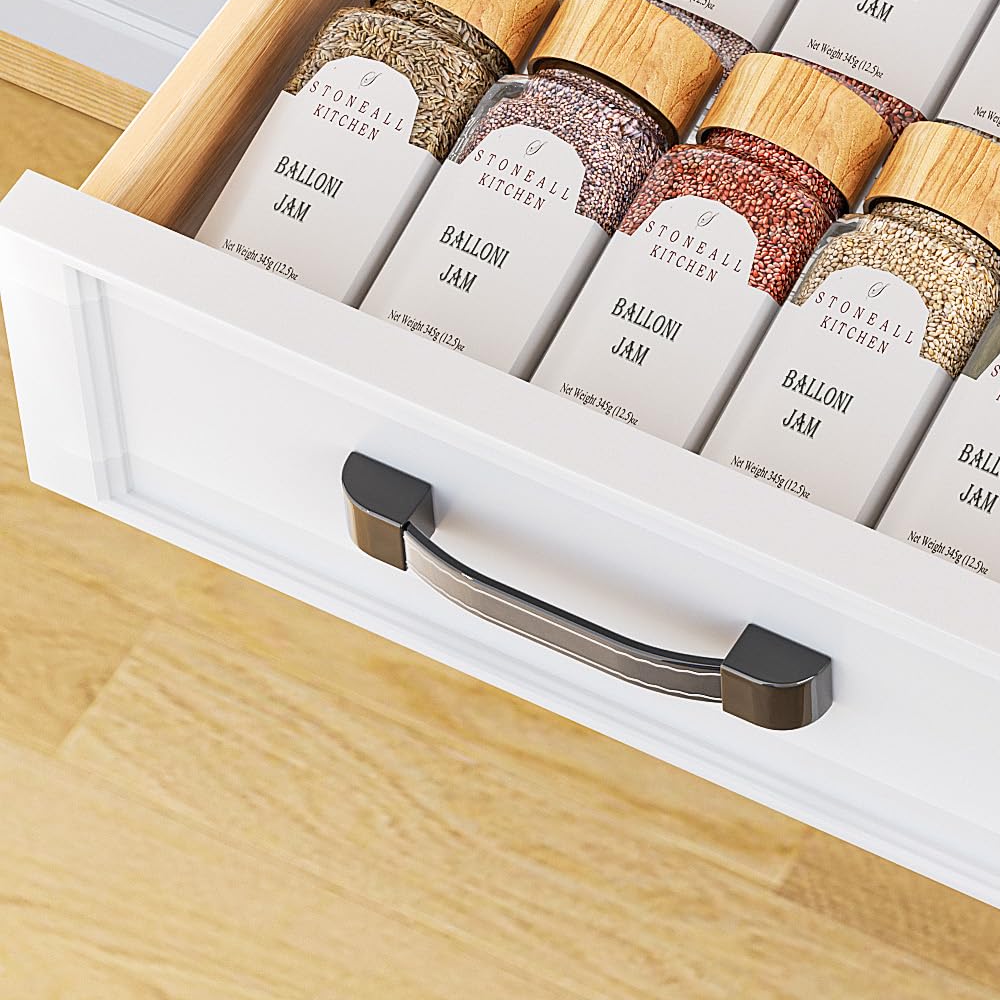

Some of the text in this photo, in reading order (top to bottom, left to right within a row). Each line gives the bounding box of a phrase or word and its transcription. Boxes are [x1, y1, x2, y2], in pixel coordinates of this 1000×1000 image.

[806, 38, 820, 50] Net
[820, 42, 843, 59] Weight
[841, 52, 859, 69] 345g
[308, 80, 403, 131] STONEALL
[312, 103, 379, 141] KITCHEN
[972, 105, 987, 118] Net
[273, 155, 343, 199] BALLONI
[473, 149, 569, 200] STONEALL
[477, 172, 545, 210] KITCHEN
[273, 193, 311, 223] JAM
[221, 238, 235, 251] Net
[235, 242, 258, 261] Weight
[256, 253, 274, 270] 345g
[438, 225, 510, 269] BALLONI
[644, 220, 742, 272] STONEALL
[649, 243, 718, 282] KITCHEN
[439, 263, 477, 293] JAM
[387, 308, 401, 322] Net
[400, 313, 424, 331] Weight
[422, 323, 440, 341] 345g
[610, 297, 682, 342] BALLONI
[814, 291, 913, 344] STONEALL
[819, 314, 889, 354] KITCHEN
[611, 336, 650, 366] JAM
[559, 382, 573, 395] Net
[573, 386, 597, 405] Weight
[594, 397, 613, 415] 345g
[781, 369, 854, 414] BALLONI
[782, 408, 821, 439] JAM
[730, 454, 744, 468] Net
[744, 459, 768, 478] Weight
[766, 470, 785, 488] 345g
[959, 483, 999, 514] JAM
[906, 530, 921, 544] Net
[921, 535, 946, 554] Weight
[943, 545, 962, 564] 345g
